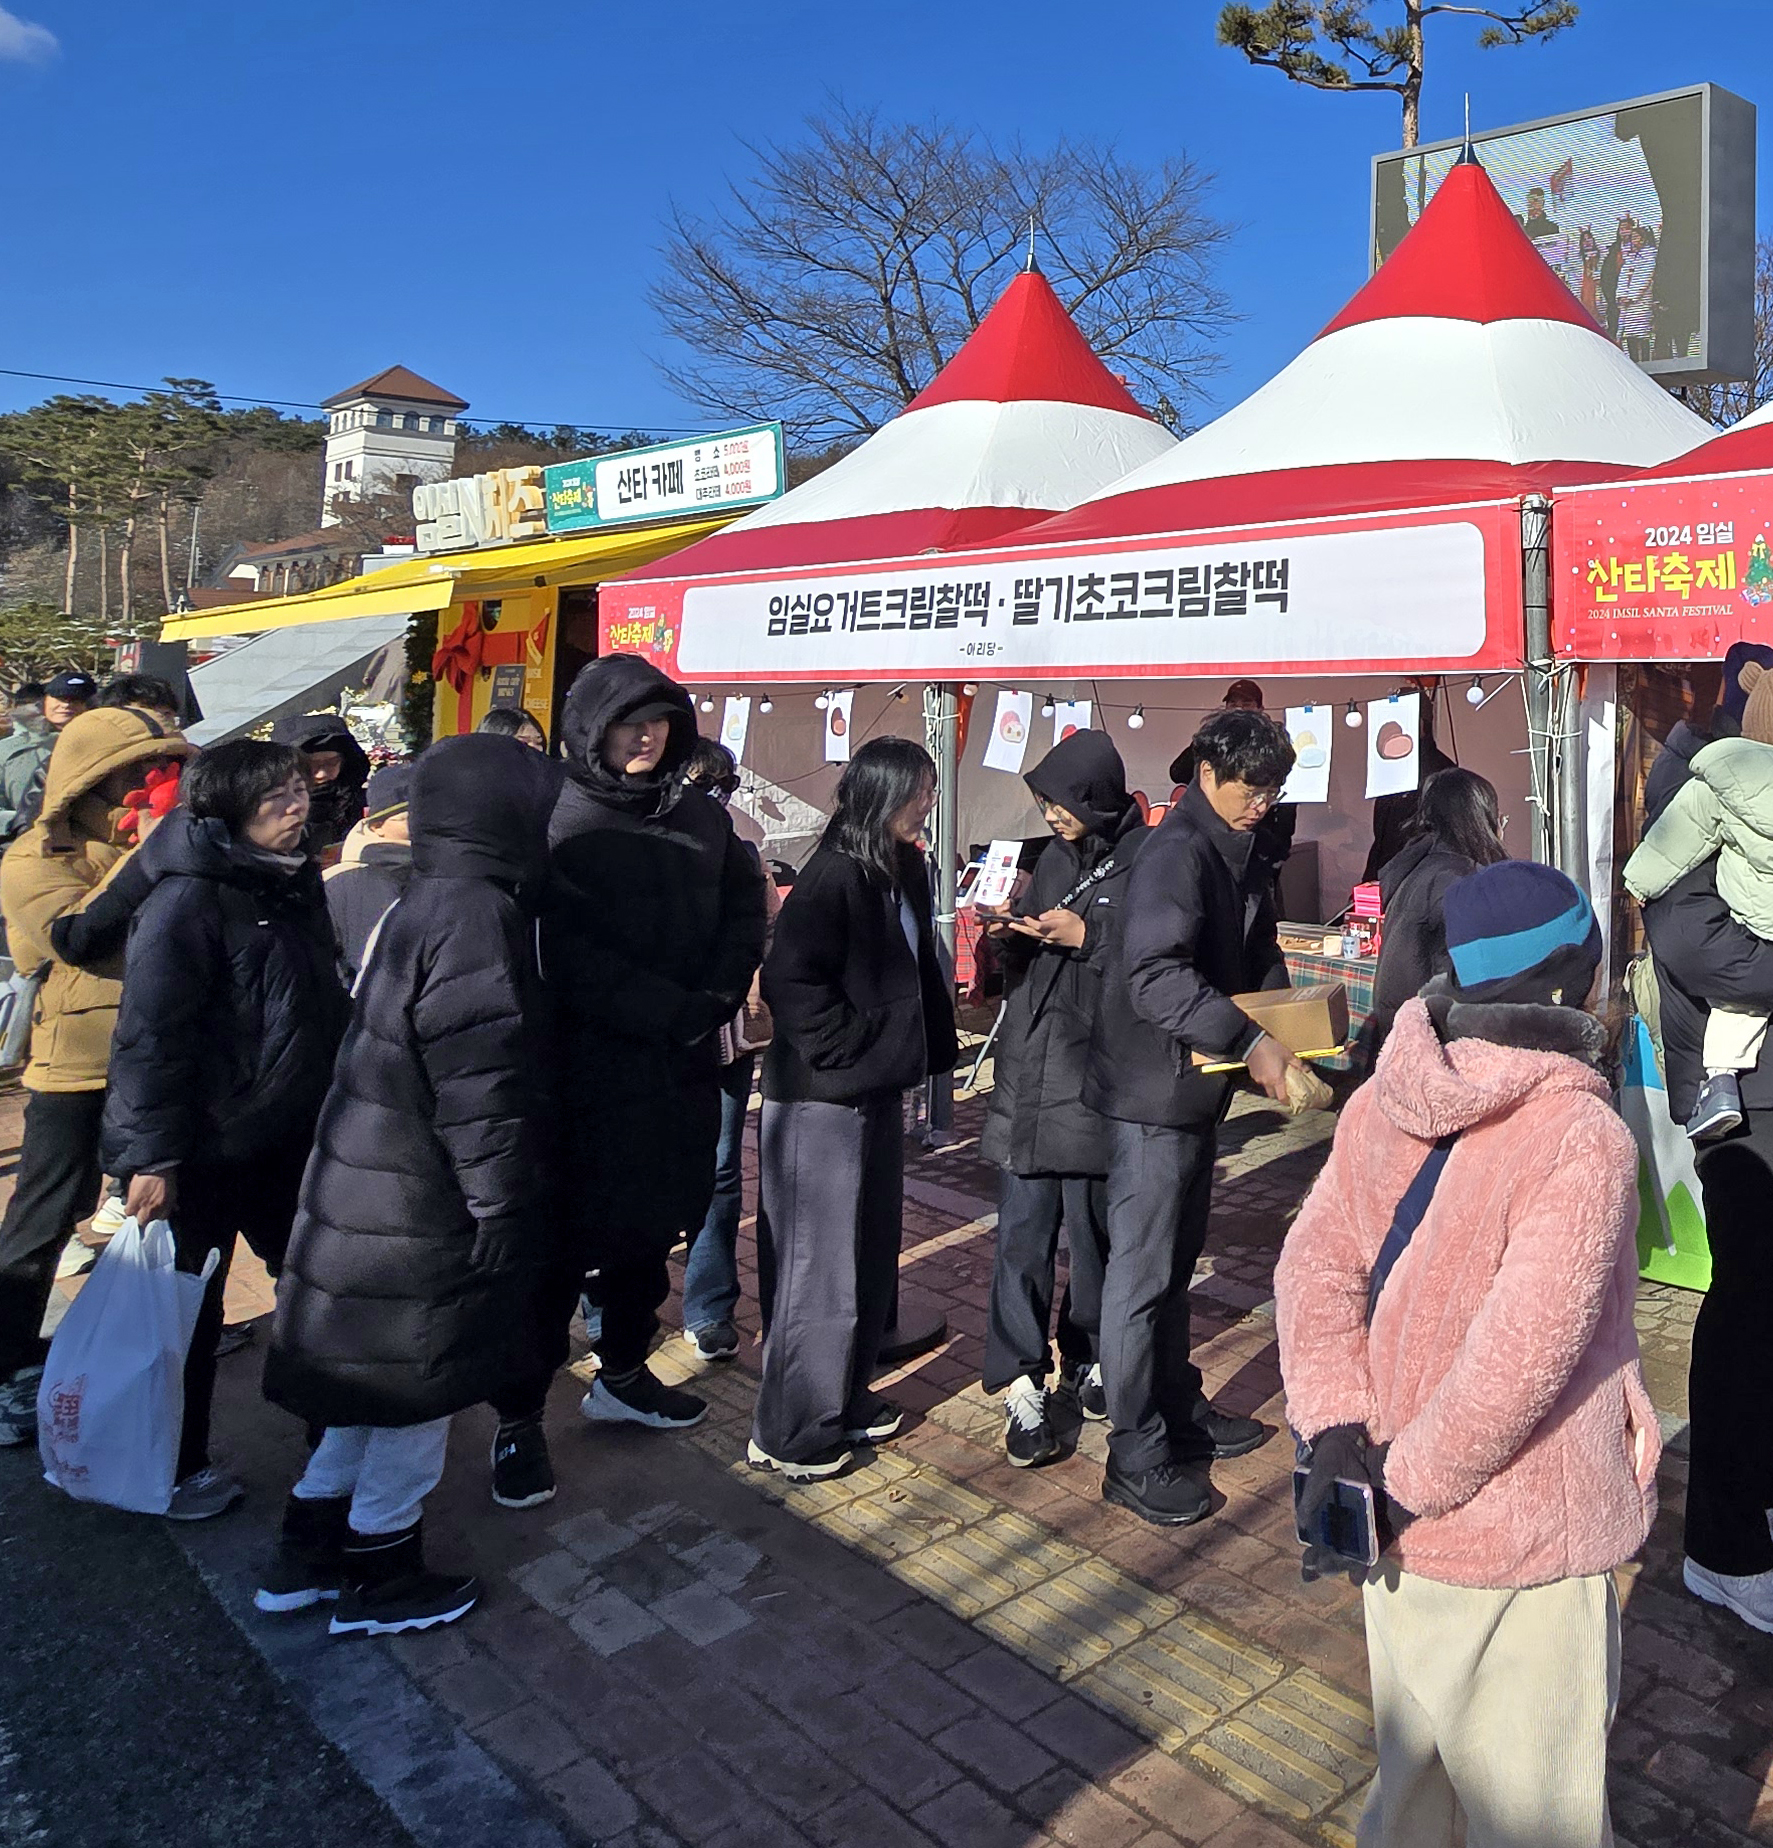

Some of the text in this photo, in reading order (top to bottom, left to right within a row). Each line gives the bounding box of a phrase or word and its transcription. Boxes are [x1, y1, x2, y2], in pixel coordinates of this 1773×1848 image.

[617, 459, 684, 503] 산타 카페
[724, 460, 751, 476] 4,000원
[725, 480, 752, 495] 4,000원
[1645, 521, 1734, 547] 2024 임실
[1587, 551, 1736, 602] 산타축제
[768, 558, 1289, 636] 임실요거트크림찰떡 딸기초코크림찰떡
[1588, 604, 1733, 619] 2024 IMSIL SANTA FESTIVAL
[610, 621, 655, 649] 산타축제
